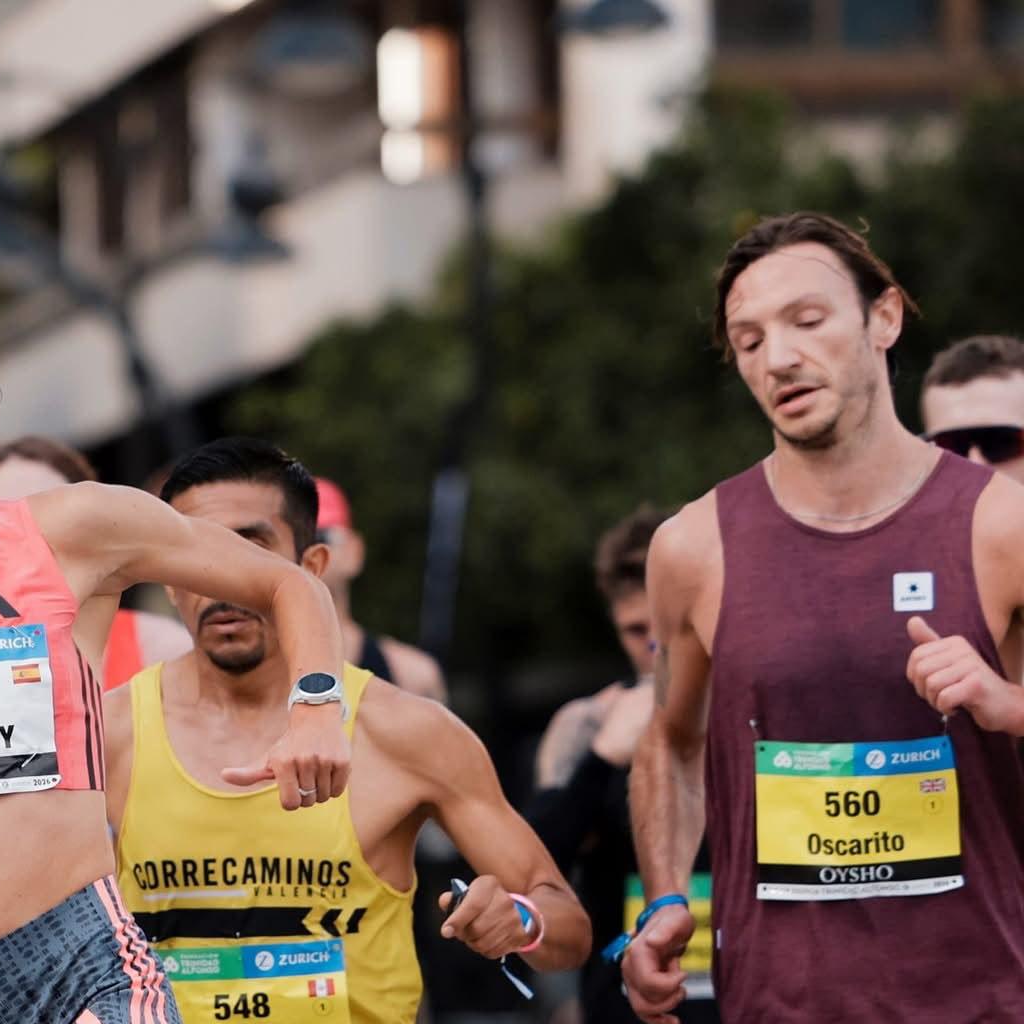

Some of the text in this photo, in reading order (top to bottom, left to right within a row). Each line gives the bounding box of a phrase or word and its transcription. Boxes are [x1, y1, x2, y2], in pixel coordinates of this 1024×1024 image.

[890, 749, 941, 764] ZURICH
[824, 790, 881, 817] 560
[807, 831, 905, 856] Oscarito
[133, 856, 352, 890] CORRECAMINOS
[819, 864, 894, 883] OYSHO
[278, 951, 329, 966] ZURICH
[214, 992, 271, 1021] 548
